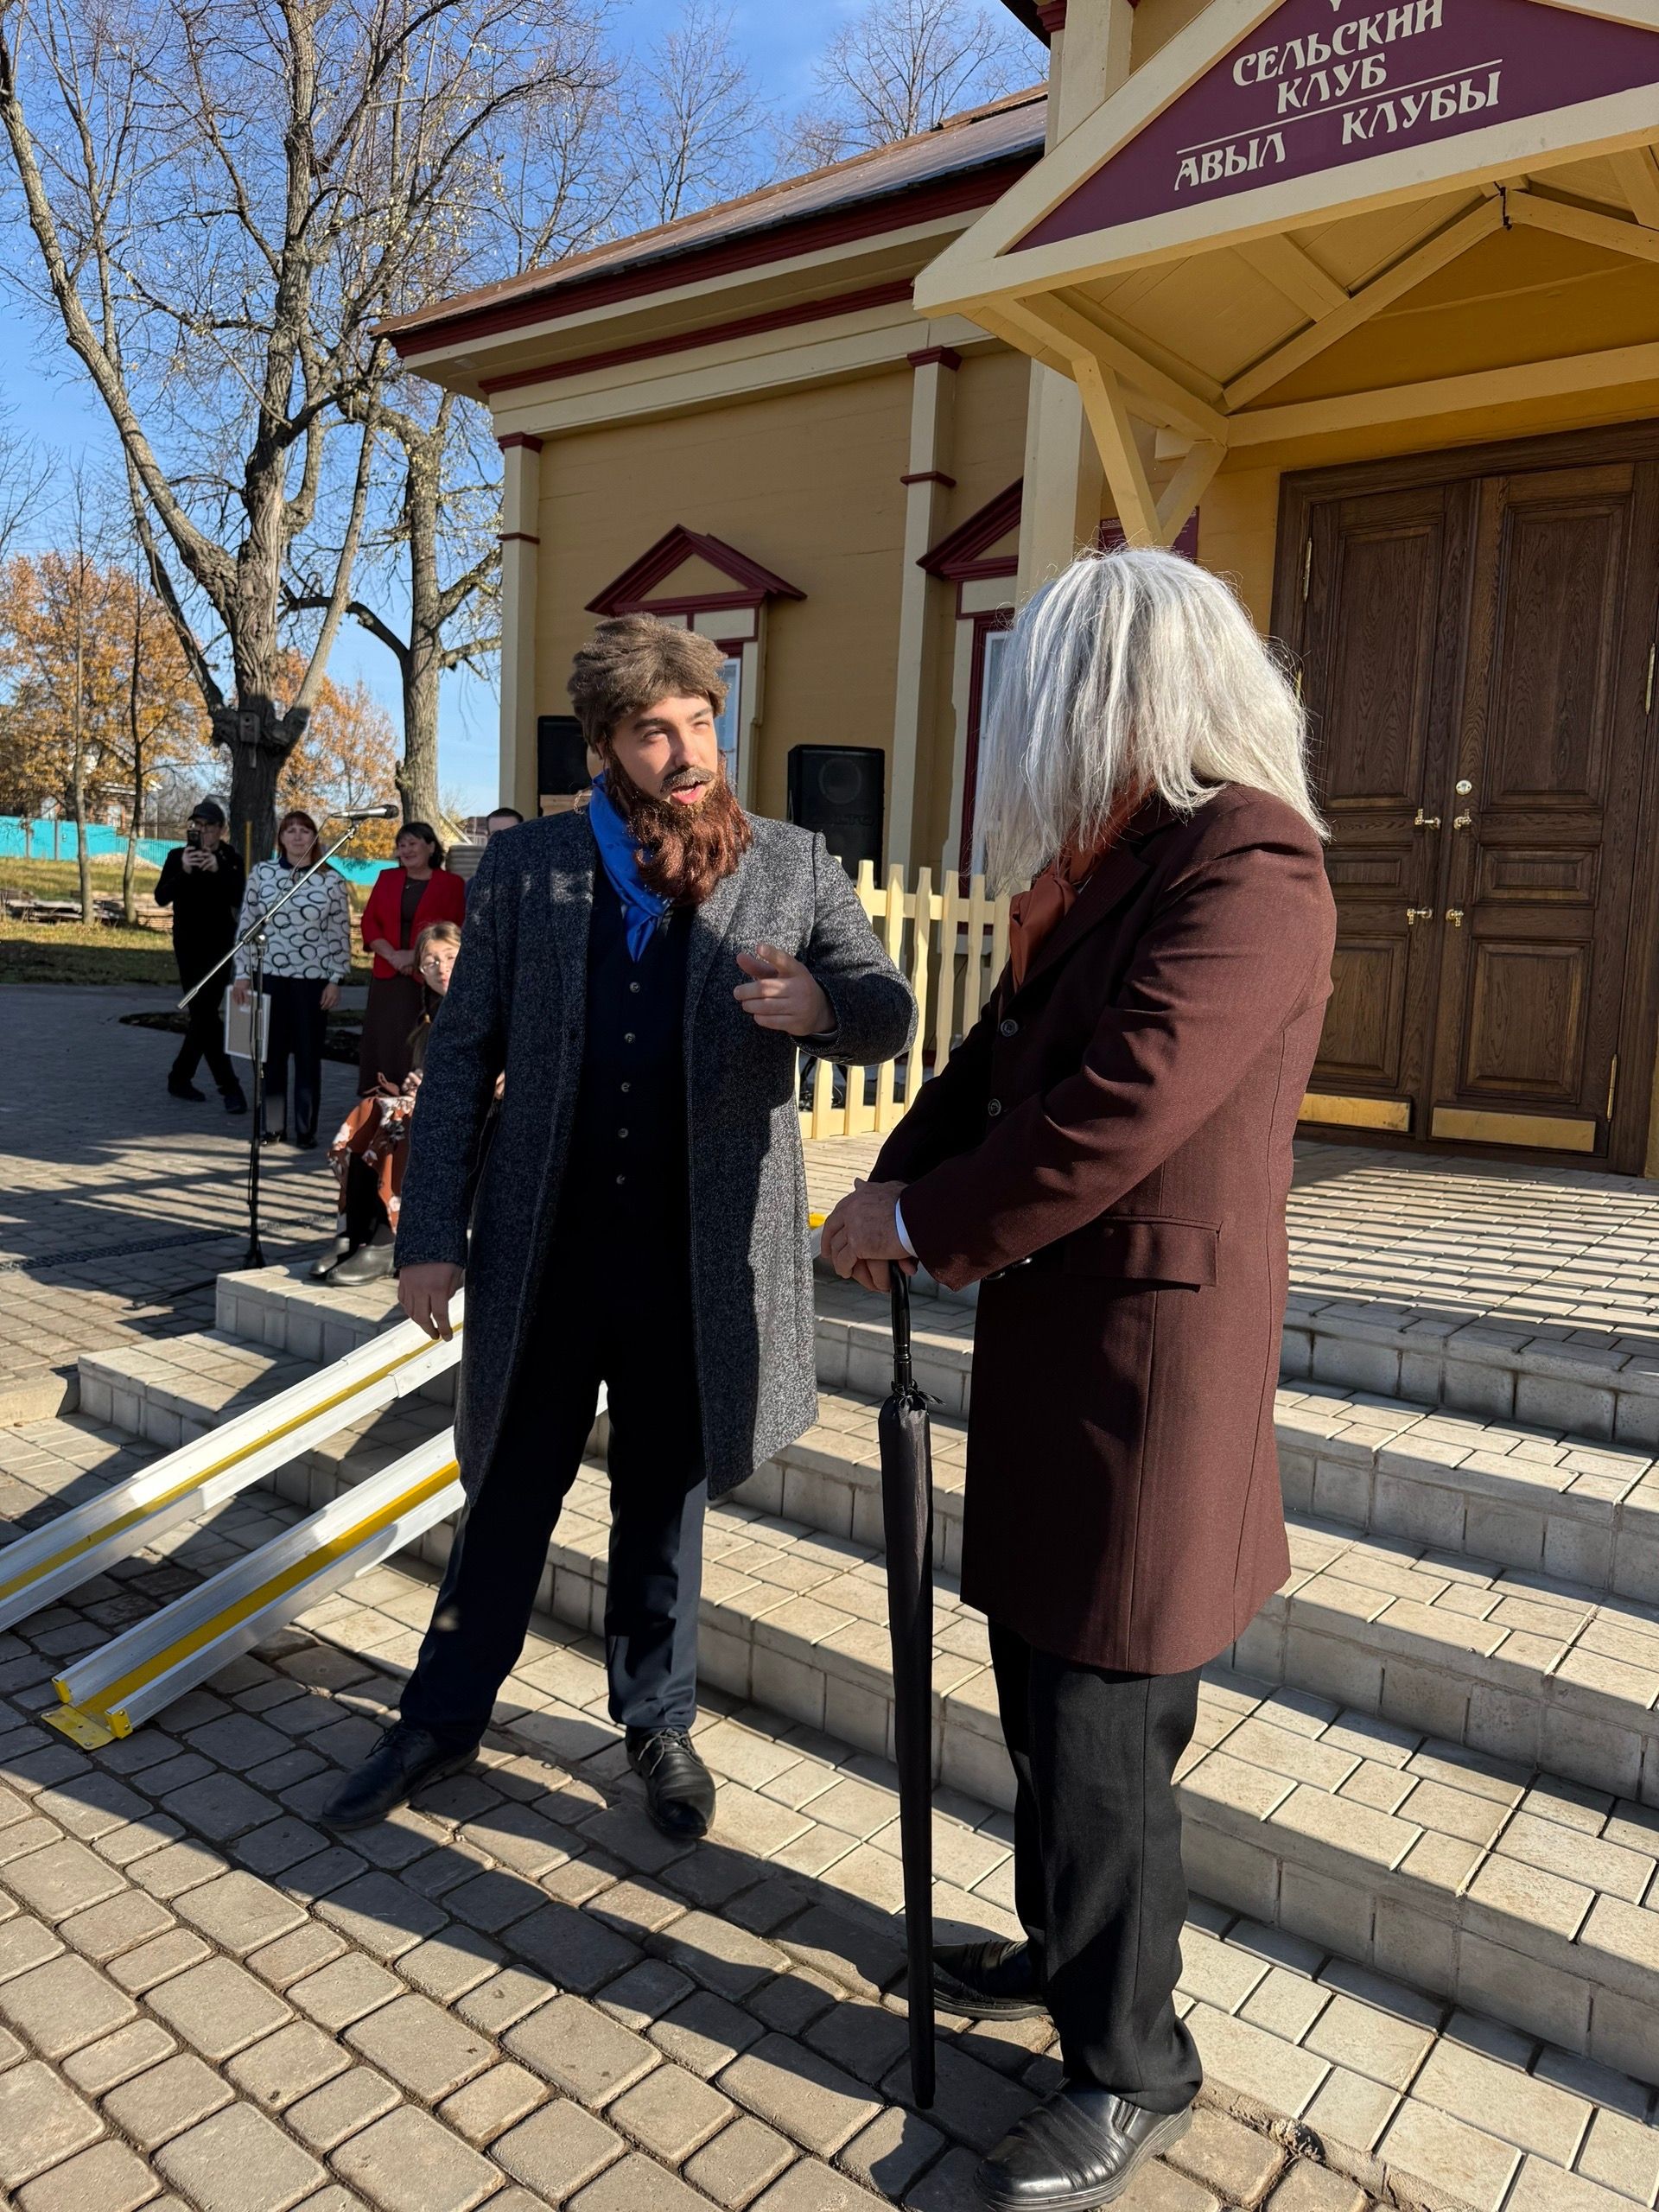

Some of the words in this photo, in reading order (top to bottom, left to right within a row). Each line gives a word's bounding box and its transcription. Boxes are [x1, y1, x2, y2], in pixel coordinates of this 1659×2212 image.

[1277, 52, 1387, 114] КЛУБ
[1173, 131, 1286, 191] АВЫЛ
[1342, 71, 1502, 145] КЛУБЫ
